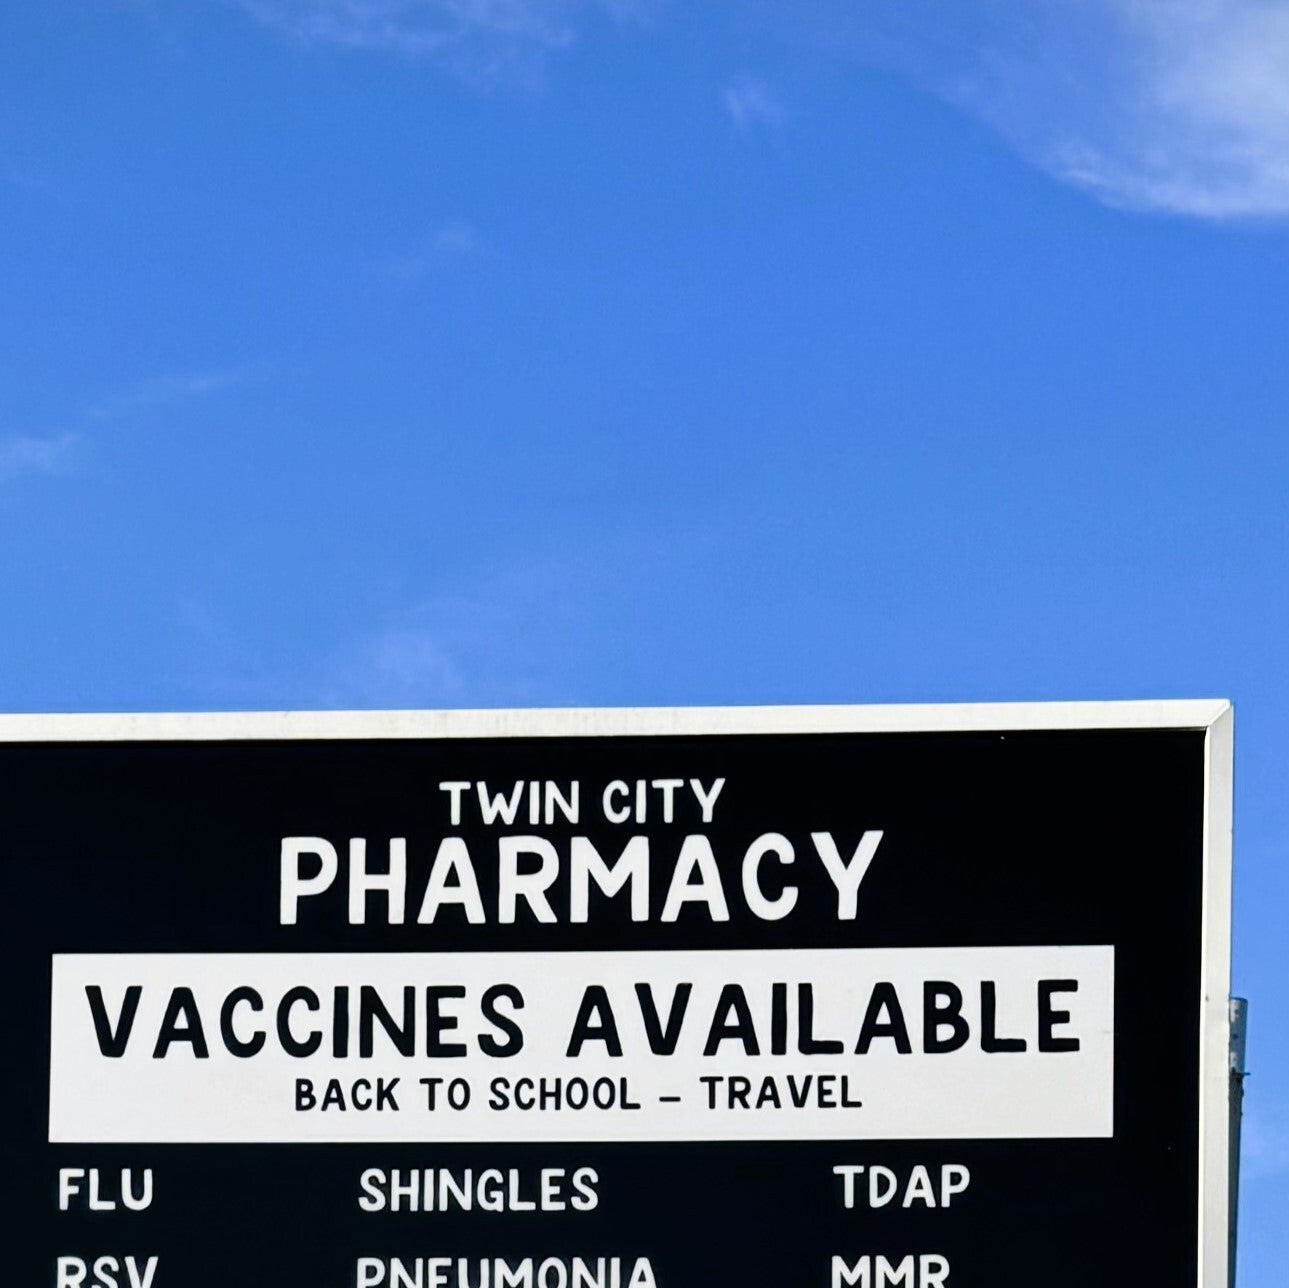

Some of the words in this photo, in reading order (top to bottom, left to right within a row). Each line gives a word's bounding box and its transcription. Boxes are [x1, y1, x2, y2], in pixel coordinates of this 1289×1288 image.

[439, 781, 579, 825] TWIN
[603, 778, 725, 823] CITY
[280, 831, 883, 924] PHARMACY
[85, 984, 524, 1058] VACCINES
[566, 979, 1079, 1057] AVAILABLE
[296, 1078, 400, 1111] BACK
[420, 1078, 470, 1111] TO
[489, 1077, 640, 1110] SCHOOL
[700, 1075, 862, 1109] TRAVEL
[60, 1169, 152, 1210] FLU
[359, 1168, 598, 1211] SHINGLES
[833, 1165, 969, 1208] TDAP
